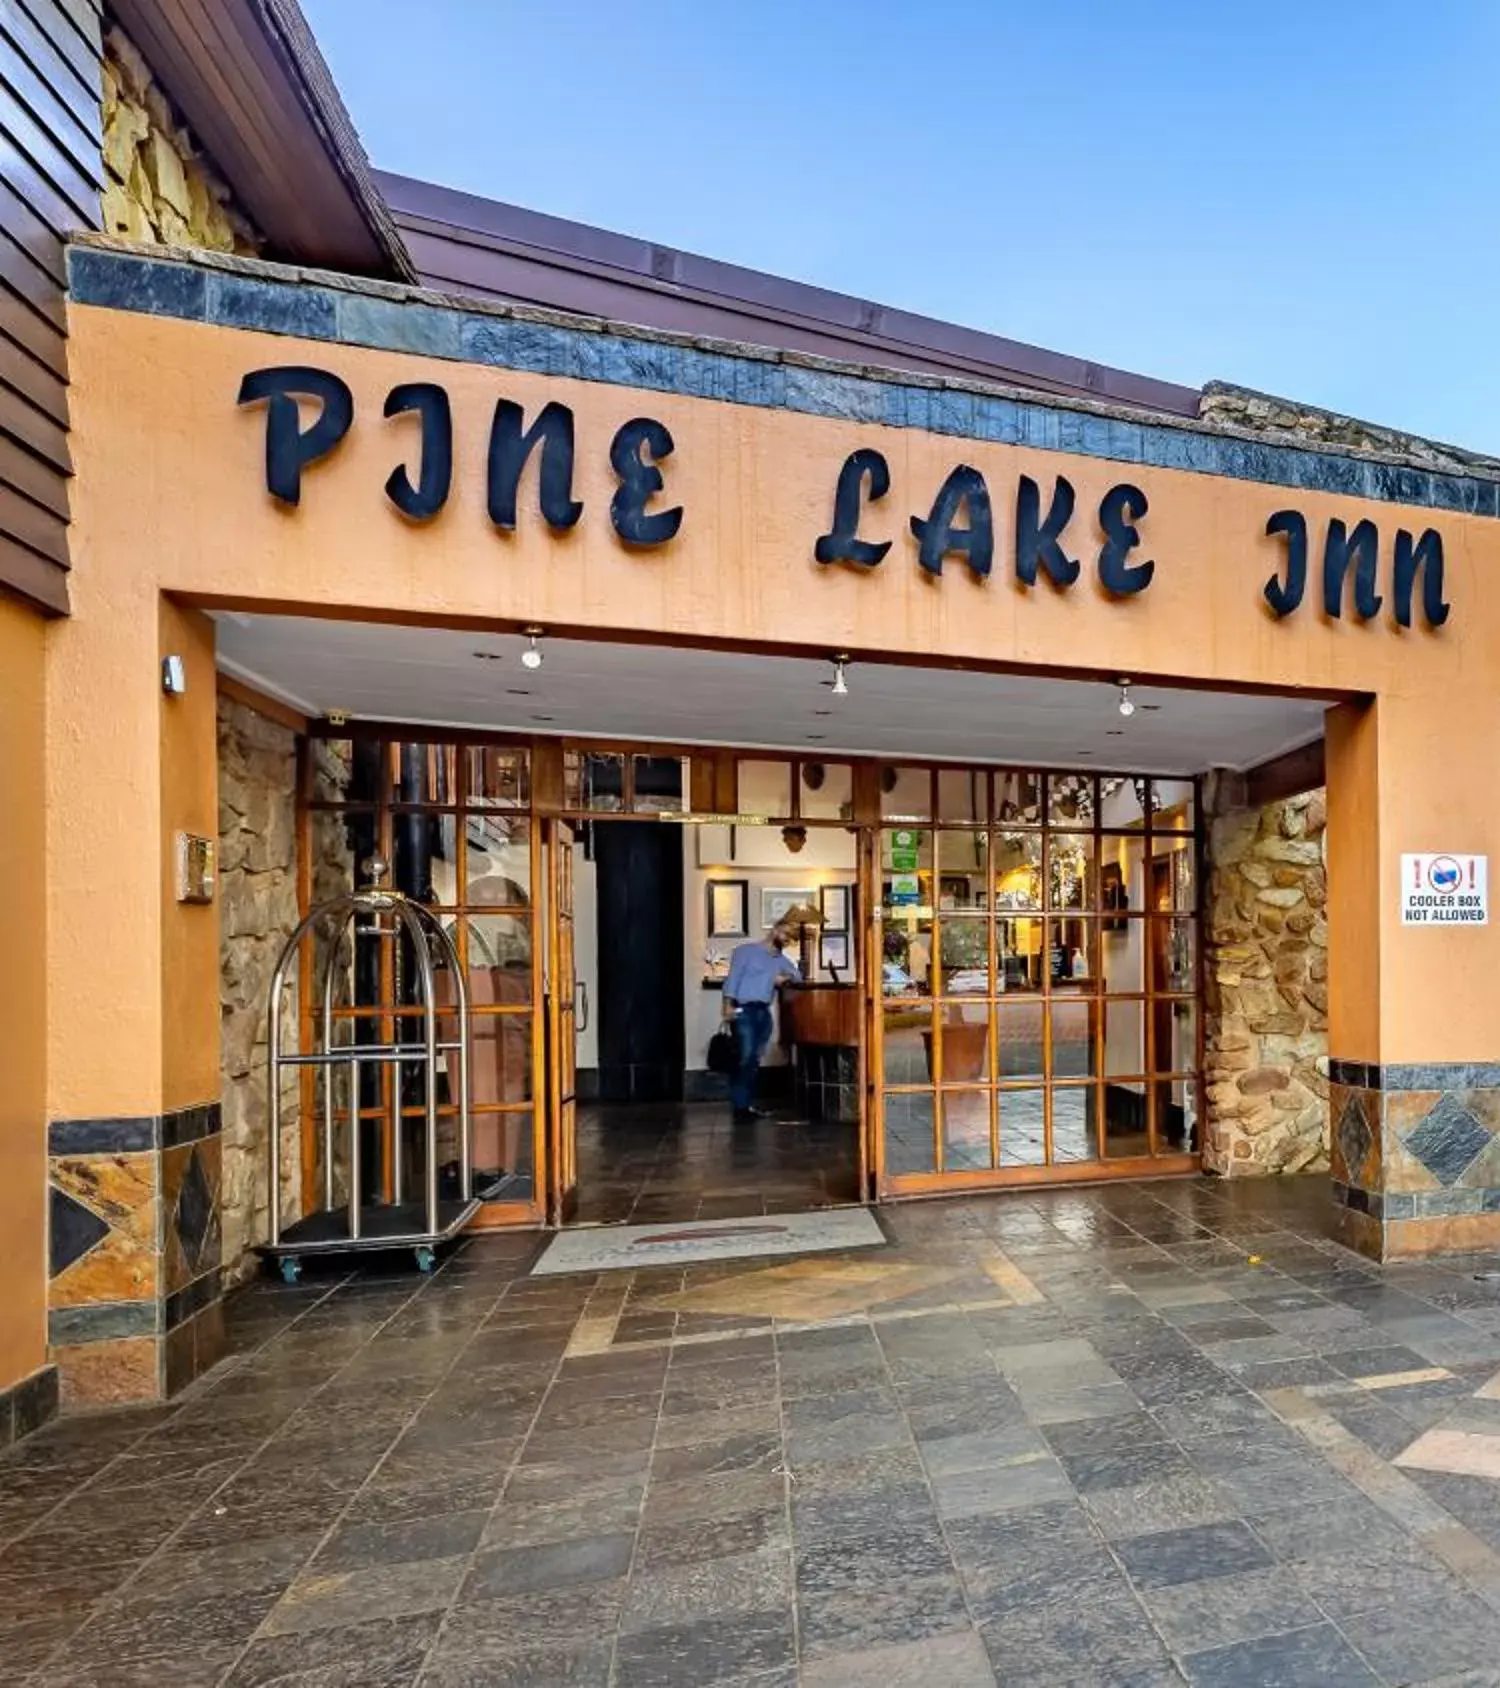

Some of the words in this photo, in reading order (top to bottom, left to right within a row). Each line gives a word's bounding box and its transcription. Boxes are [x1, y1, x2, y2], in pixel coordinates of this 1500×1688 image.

[238, 366, 684, 548] PINE
[815, 449, 1155, 600] LAKE
[1264, 510, 1451, 630] INN
[1409, 895, 1455, 907] COOLER
[1457, 895, 1481, 907] BOX
[1405, 909, 1428, 921] NOT
[1431, 909, 1485, 921] ALLOWED
